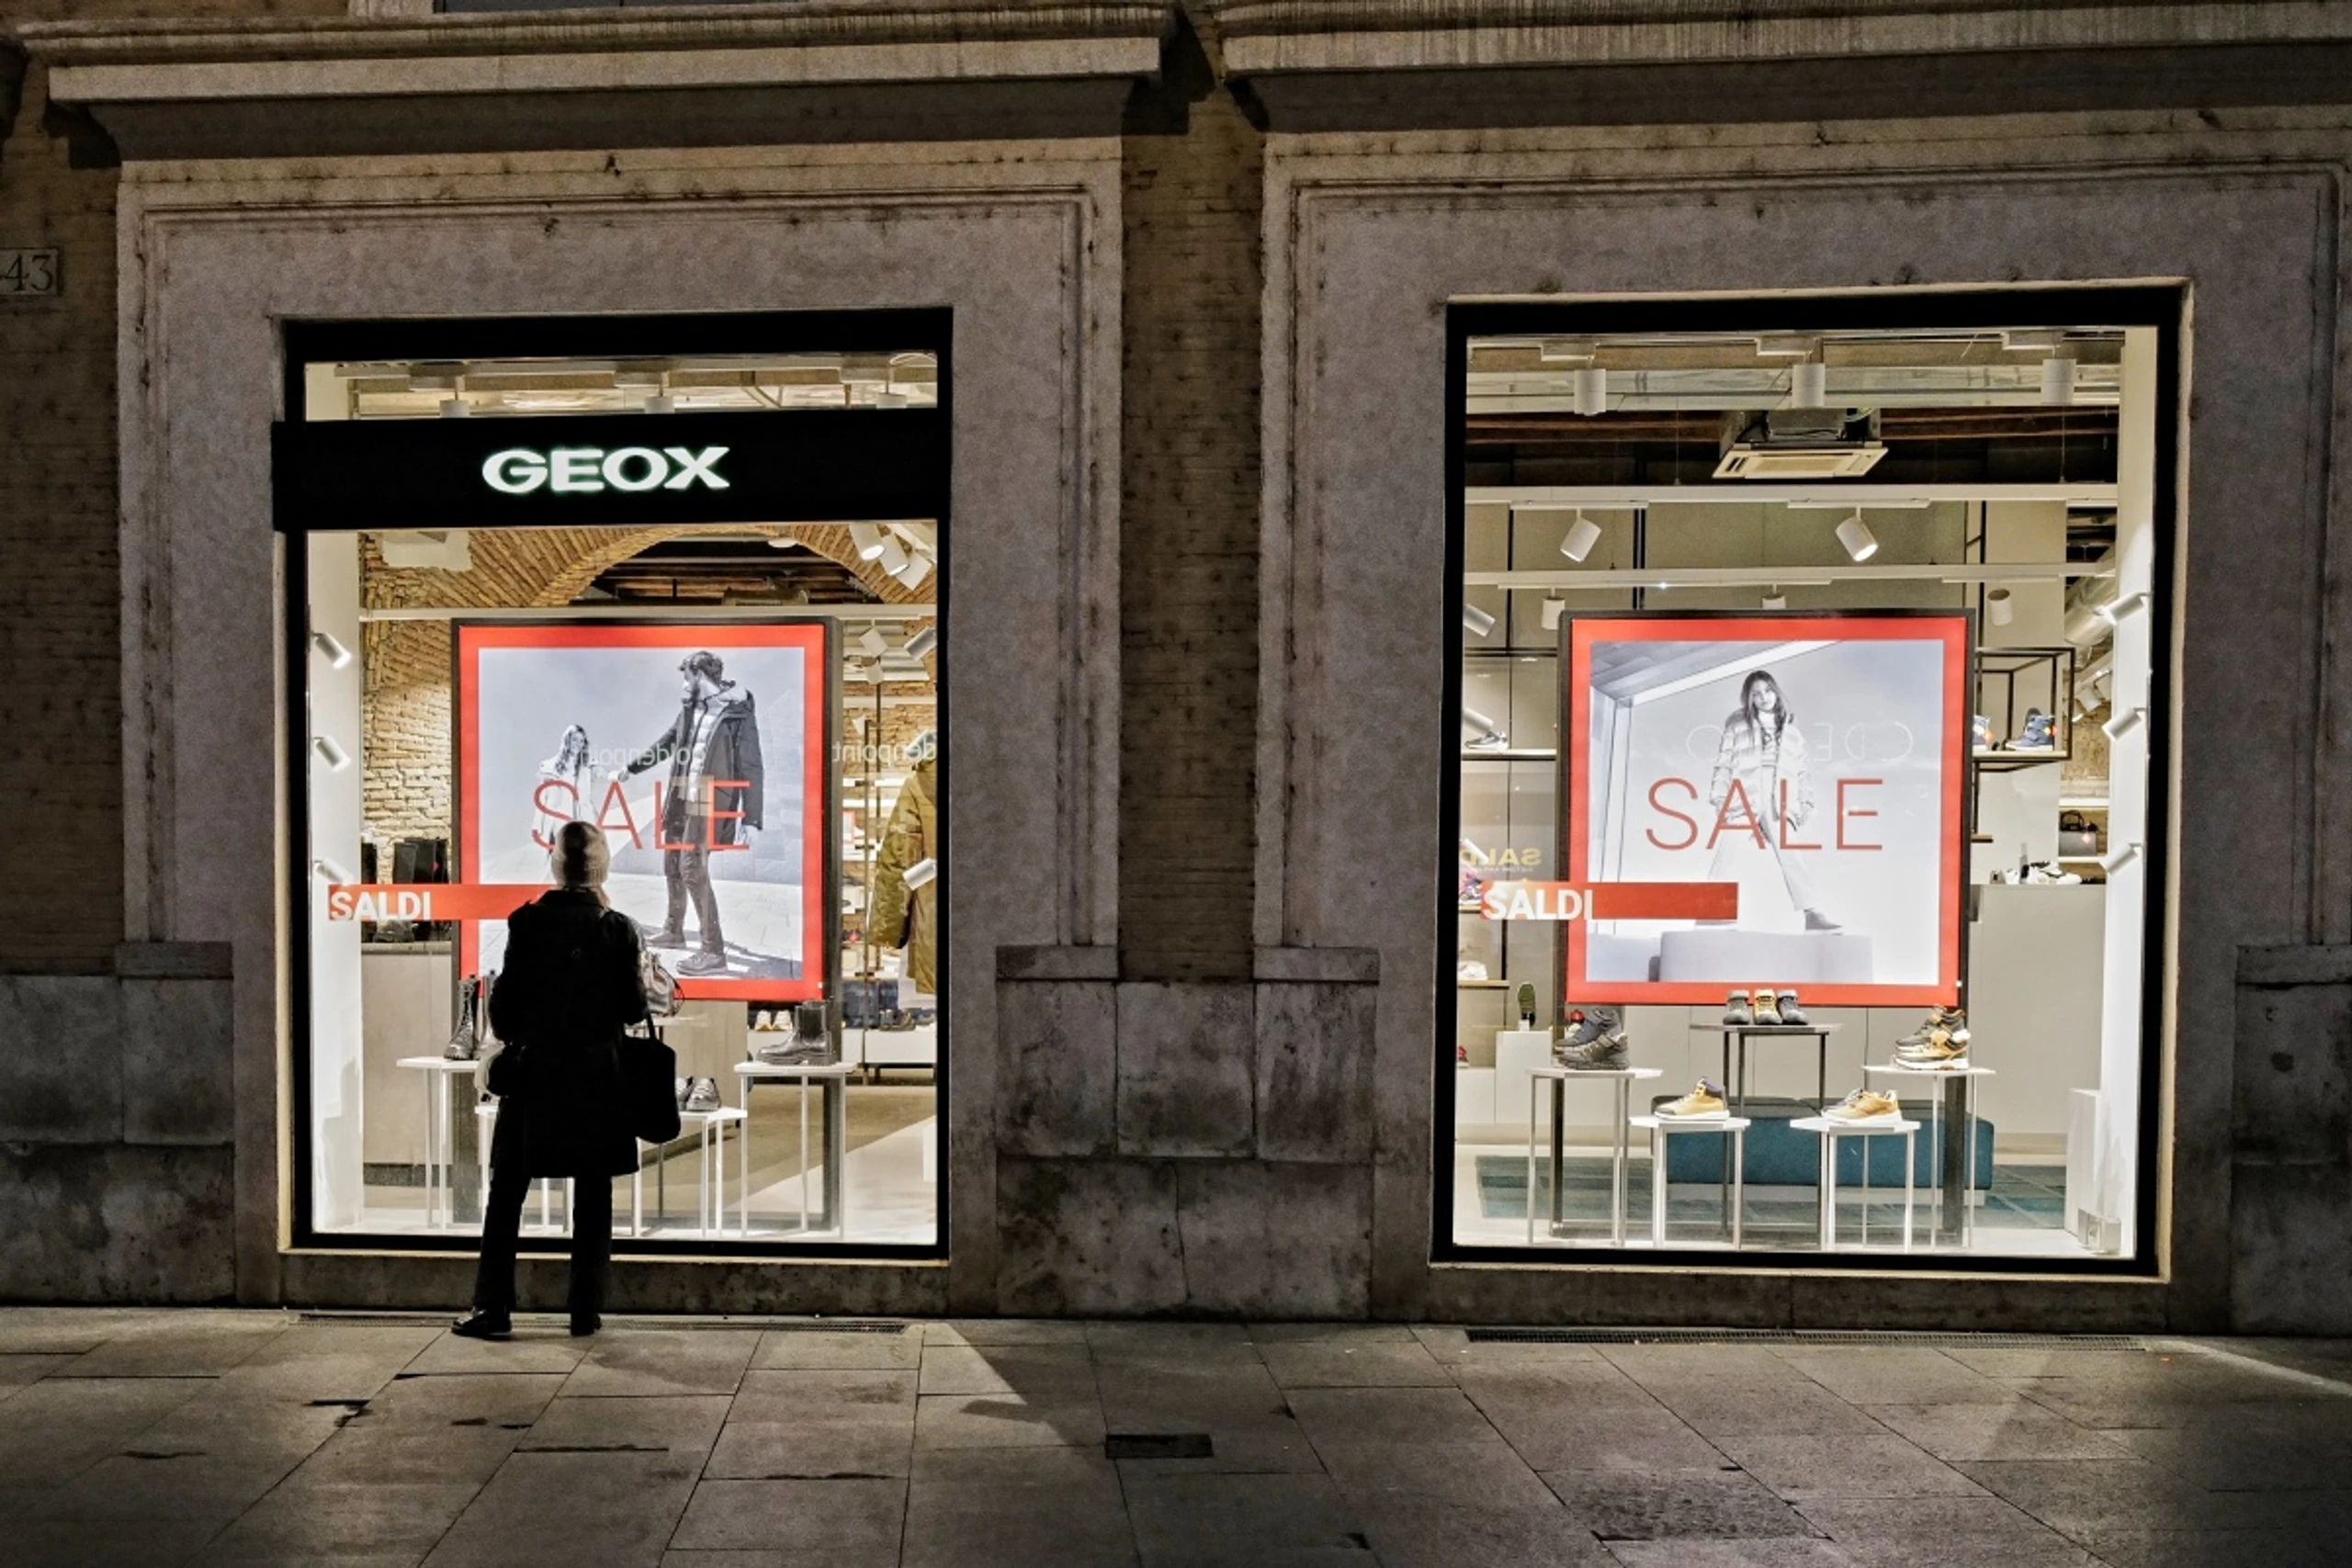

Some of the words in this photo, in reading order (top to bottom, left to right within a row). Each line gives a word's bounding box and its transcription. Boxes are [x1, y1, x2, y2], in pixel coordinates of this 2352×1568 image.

[481, 446, 730, 494] GEOX
[532, 779, 751, 851] SALE
[1645, 777, 1883, 851] SALE
[330, 890, 431, 920] SALDI
[1482, 887, 1593, 920] SALDI
